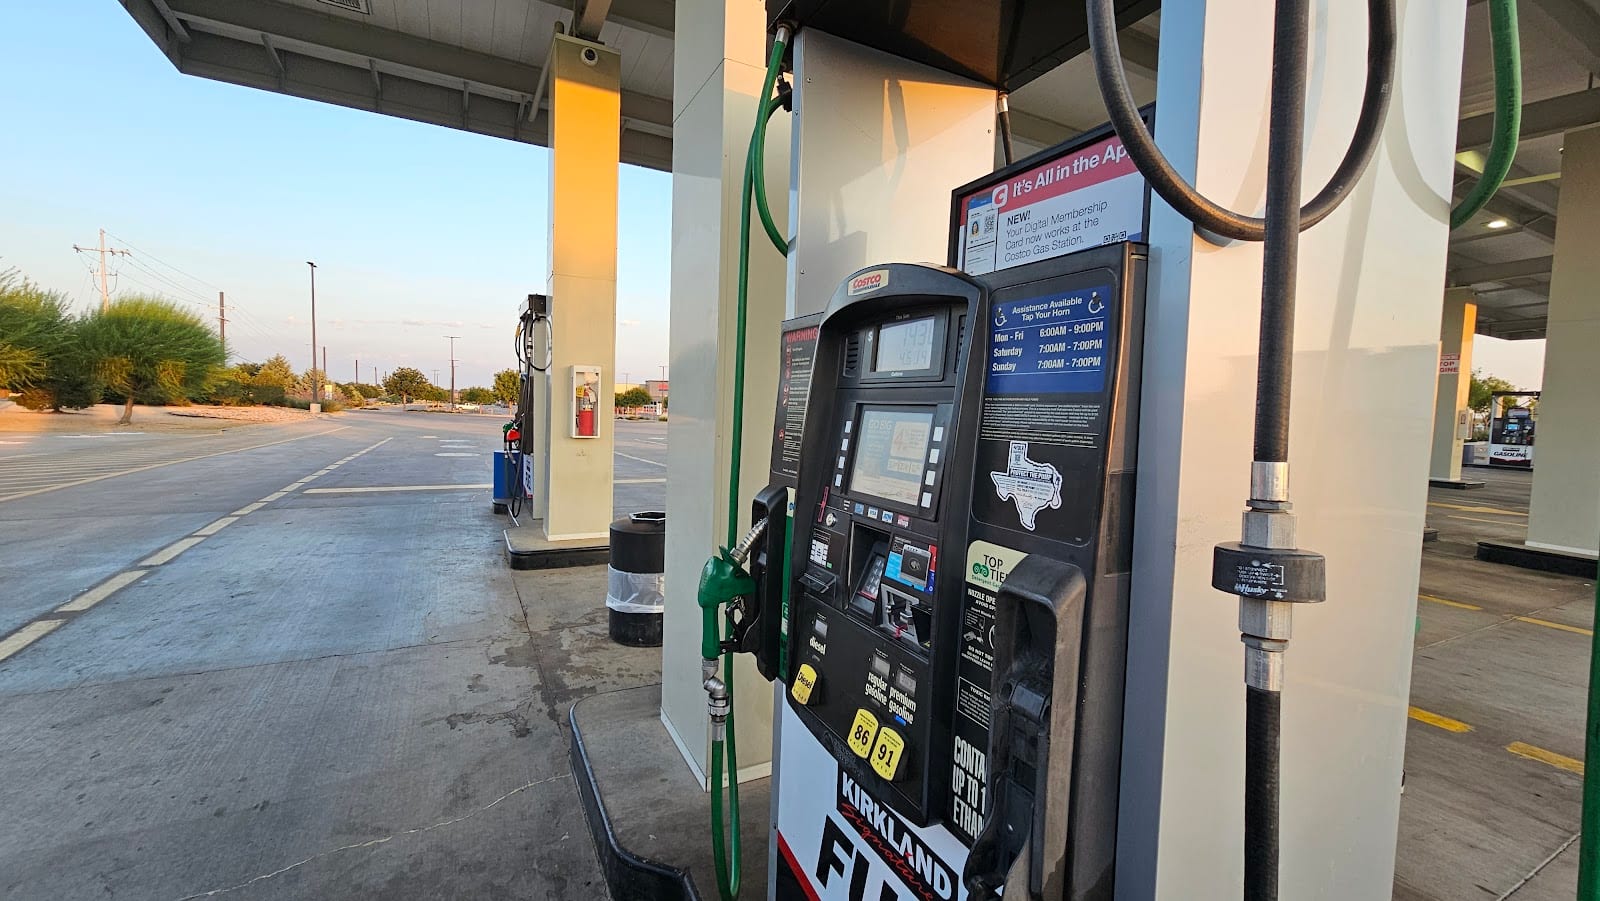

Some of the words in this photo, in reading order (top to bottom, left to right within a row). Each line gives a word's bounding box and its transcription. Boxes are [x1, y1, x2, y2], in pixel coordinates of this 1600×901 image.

[1012, 179, 1033, 198] It's
[1034, 169, 1054, 190] All
[1055, 164, 1070, 181] in
[1072, 153, 1100, 175] the
[1102, 144, 1130, 165] Ap
[1006, 223, 1024, 239] Your
[1024, 217, 1049, 236] Digital
[1050, 200, 1108, 226] Membership
[1007, 210, 1031, 226] NEW!
[1005, 236, 1024, 251] Card
[1025, 233, 1043, 246] now
[1044, 225, 1071, 241] works
[1072, 222, 1082, 234] at
[1084, 216, 1100, 230] the
[1004, 249, 1031, 263] Costco
[1032, 242, 1050, 257] Gas
[1051, 235, 1084, 252] Station.
[853, 274, 882, 289] COSTCO
[1012, 303, 1048, 314] Assistance
[1049, 297, 1083, 309] Available
[1022, 313, 1034, 322] Tap
[1035, 311, 1051, 320] Your
[1052, 307, 1071, 317] Horn
[786, 327, 818, 343] WARNING
[994, 333, 1009, 343] Mon
[1014, 331, 1024, 341] Fri
[1039, 325, 1067, 338] 6:00AM
[1073, 321, 1104, 334] 9:00PM
[993, 347, 1023, 358] Saturday
[1039, 342, 1066, 353] 7:00AM
[1073, 339, 1103, 351] 7:00PM
[992, 362, 1017, 372] Sunday
[1037, 359, 1065, 369] 7:00AM
[1071, 356, 1101, 368] 7:00PM
[983, 554, 1004, 570] TOP
[990, 569, 1009, 583] TIE
[810, 635, 826, 655] diesel
[798, 671, 814, 689] Diesel
[868, 672, 888, 691] regular
[864, 683, 888, 705] gasoline
[889, 686, 917, 712] premium
[888, 700, 914, 725] gasoline
[854, 724, 870, 746] 86
[878, 744, 893, 768] 91
[953, 735, 988, 785] CONTA
[952, 764, 966, 796] UP
[966, 774, 979, 809] TO
[842, 771, 952, 900] KIRKLAND
[840, 801, 933, 901] Signature
